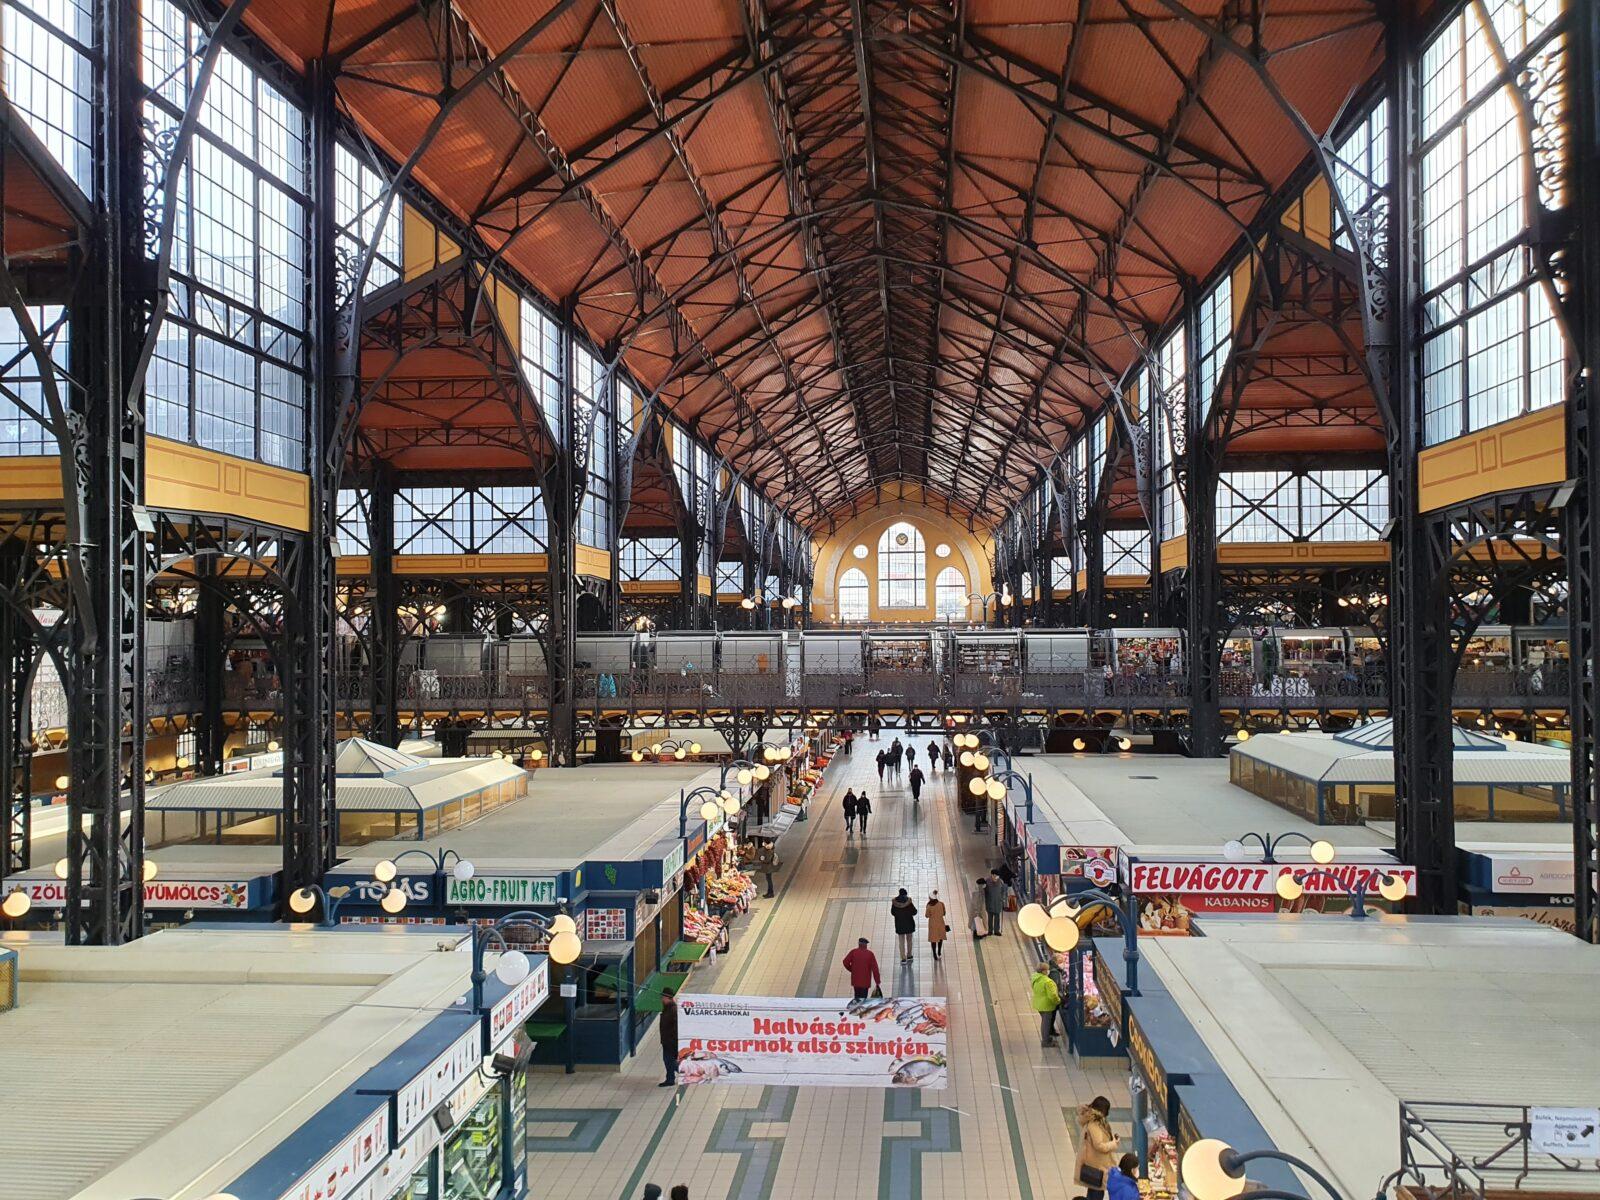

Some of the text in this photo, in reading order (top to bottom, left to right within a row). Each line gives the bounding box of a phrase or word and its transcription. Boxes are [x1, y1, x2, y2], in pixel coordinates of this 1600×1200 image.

[1133, 865, 1269, 891] FELVÁGOTT
[450, 879, 528, 902] AGRO-FRUIT
[1204, 896, 1270, 908] KABANOS
[695, 1001, 751, 1011] BUDAPEST
[753, 1016, 866, 1036] Halvásár
[689, 1035, 934, 1059] a csarnok alsó szintjén.
